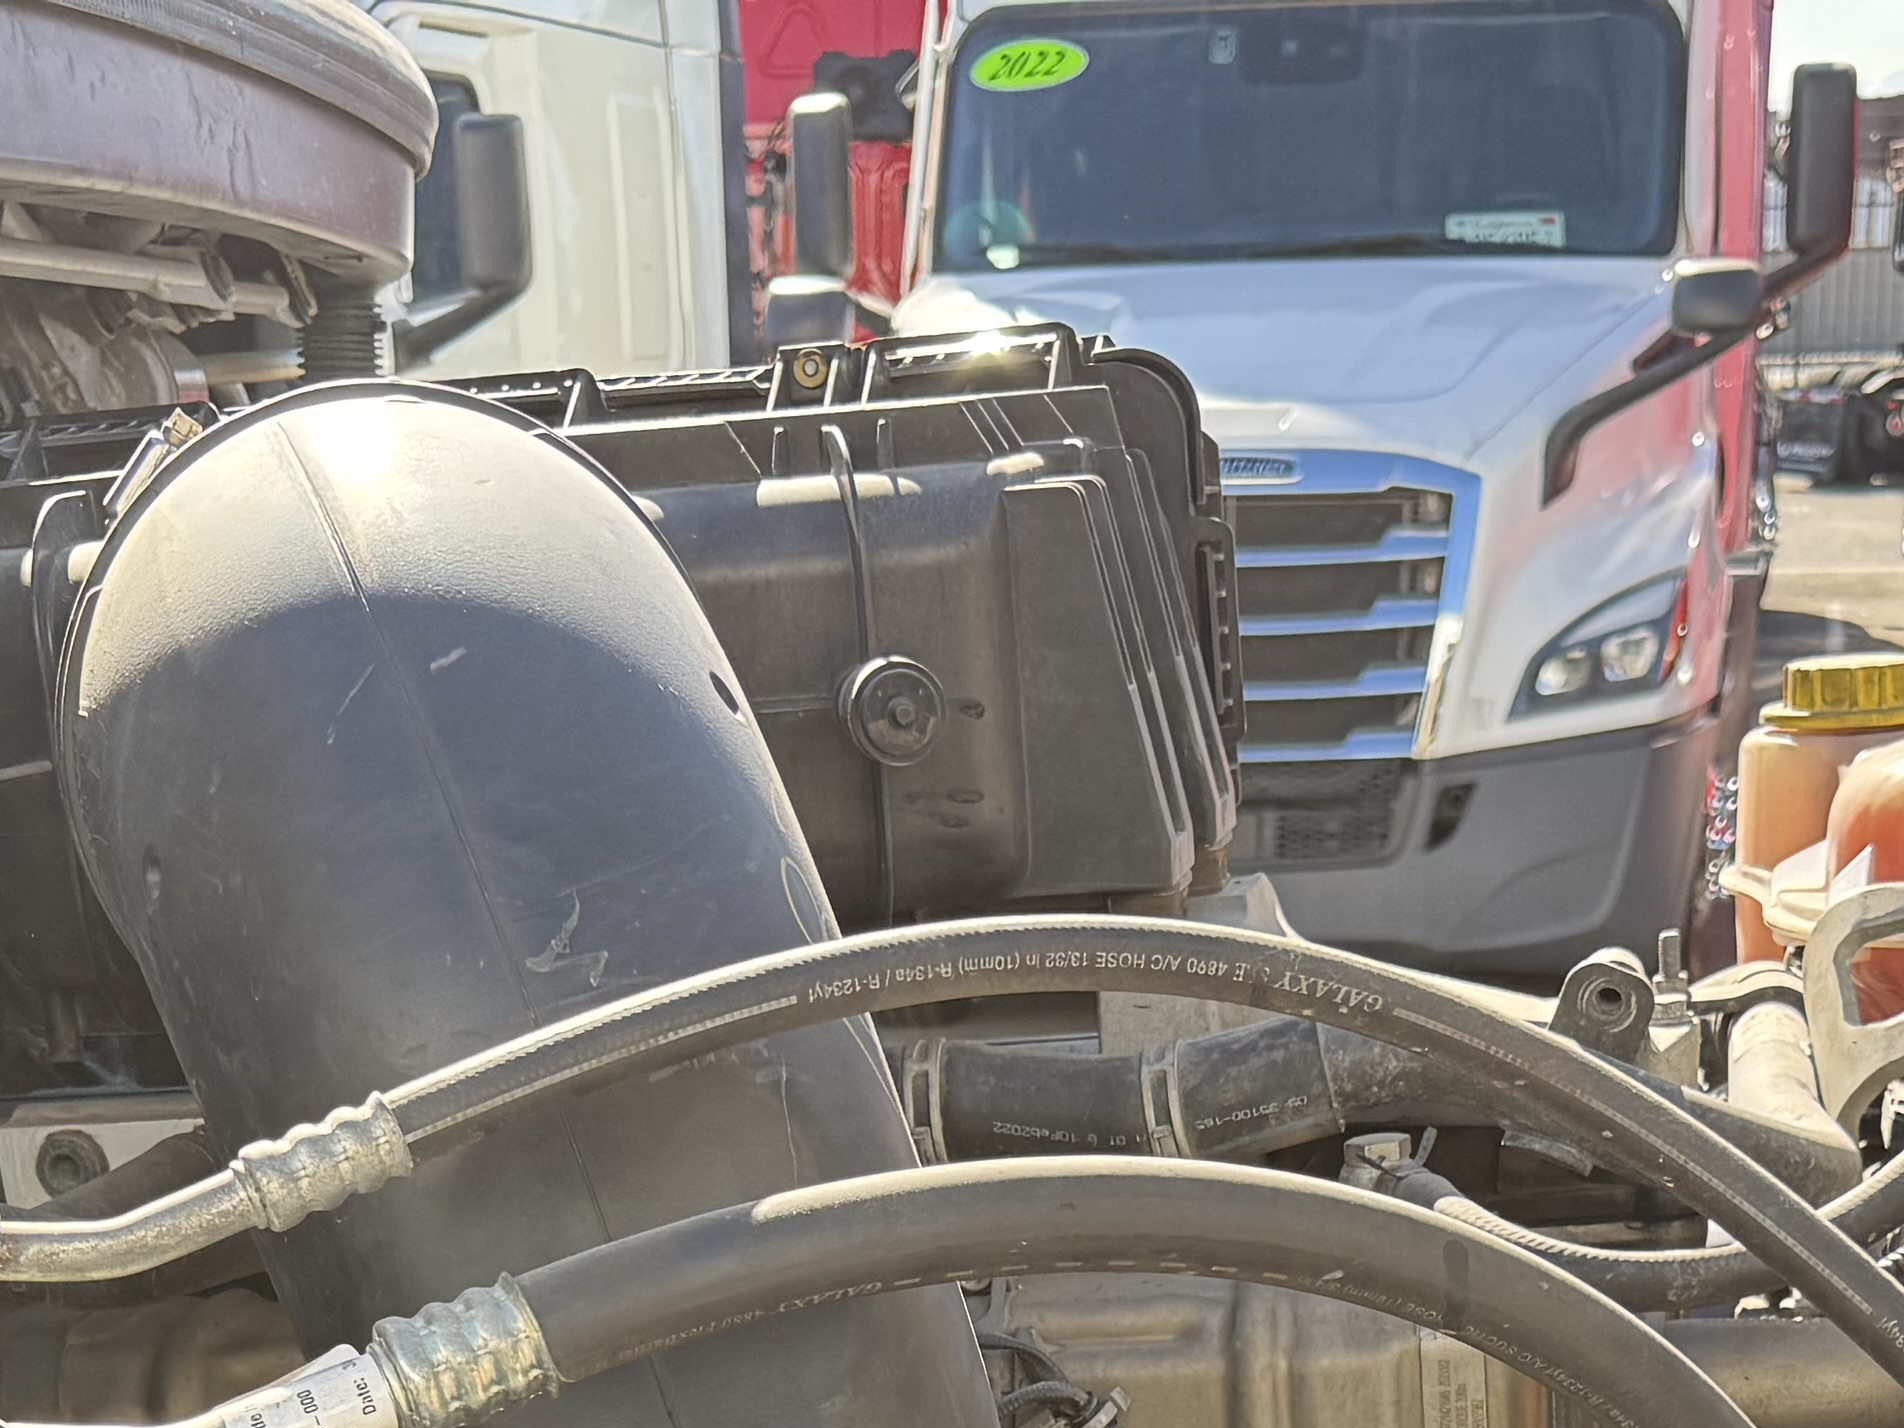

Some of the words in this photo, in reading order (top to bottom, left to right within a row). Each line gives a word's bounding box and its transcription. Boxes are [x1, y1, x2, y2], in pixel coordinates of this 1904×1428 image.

[988, 49, 1068, 83] 2022
[958, 953, 1020, 975] (10mm)
[1045, 951, 1089, 968] 13/32
[1095, 951, 1146, 968] HOSE
[1150, 954, 1181, 972] A/C
[1186, 959, 1228, 977] 4890
[895, 962, 952, 982] R-134a
[807, 973, 881, 1004] R-1234yf
[1274, 971, 1384, 1013] GALAXY
